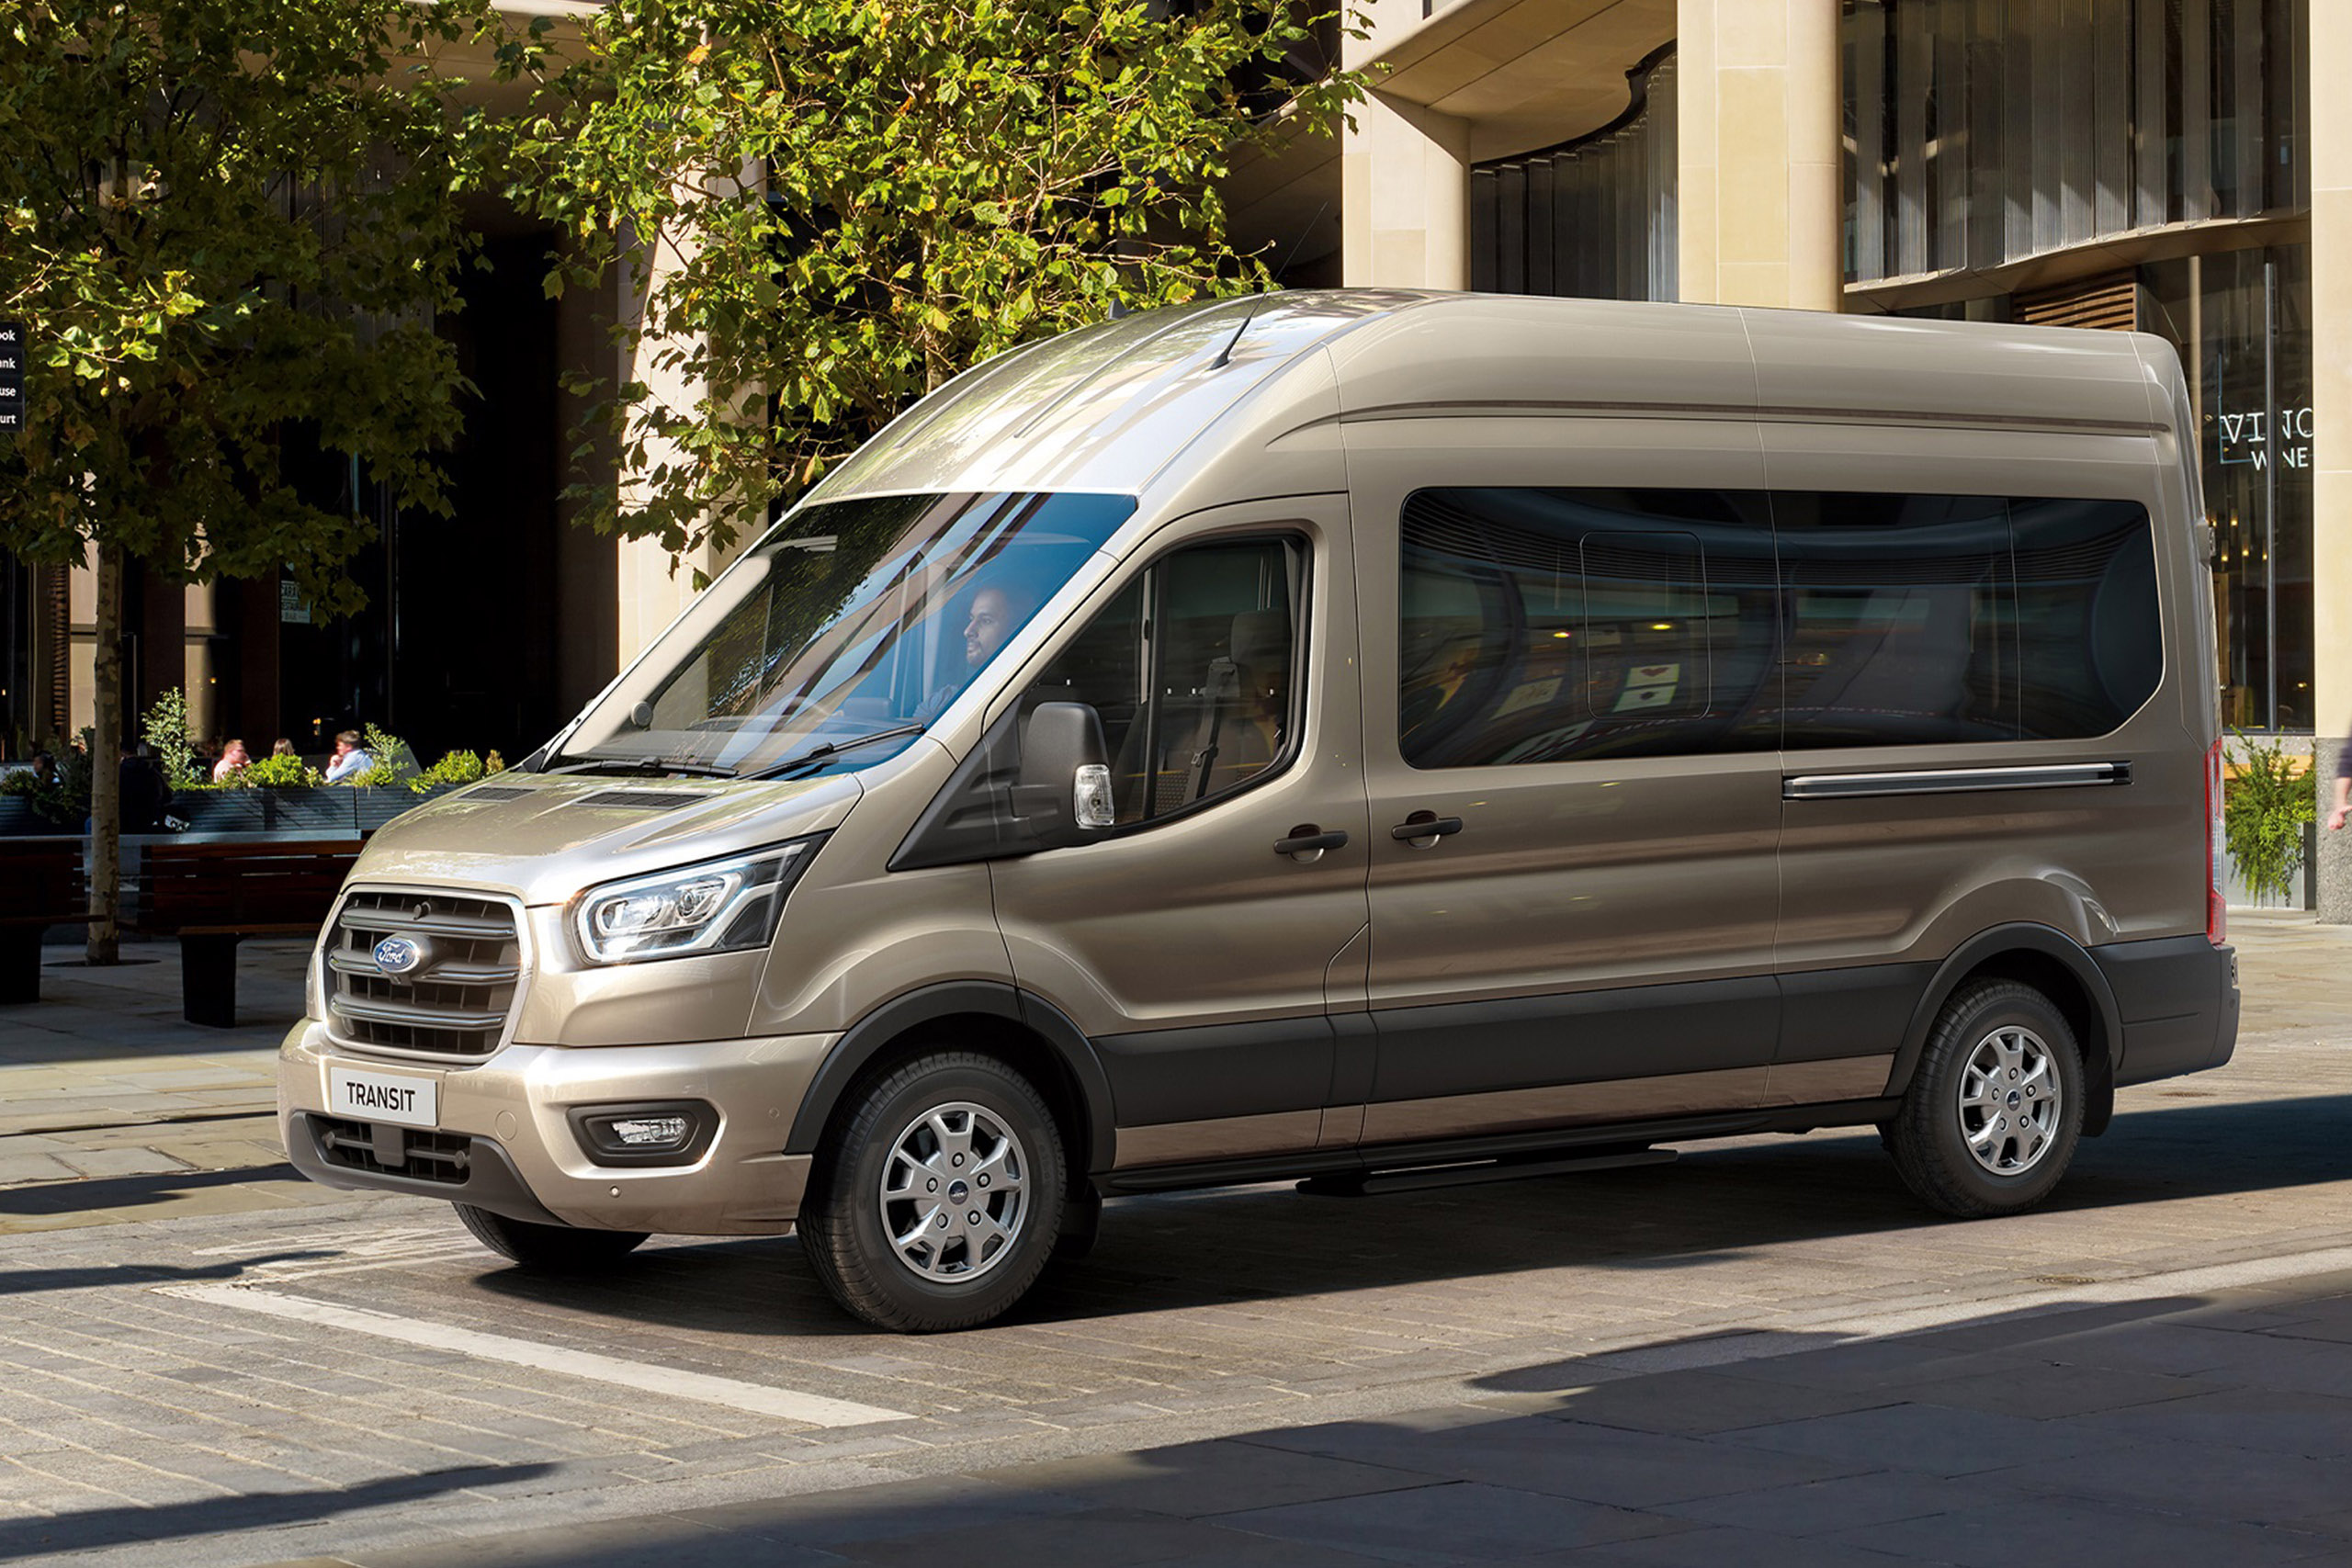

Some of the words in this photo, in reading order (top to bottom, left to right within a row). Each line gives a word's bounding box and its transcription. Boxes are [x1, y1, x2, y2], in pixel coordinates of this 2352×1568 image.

[2251, 447, 2309, 471] WNE
[378, 942, 406, 964] Ford
[346, 1082, 415, 1112] TRANSIT
